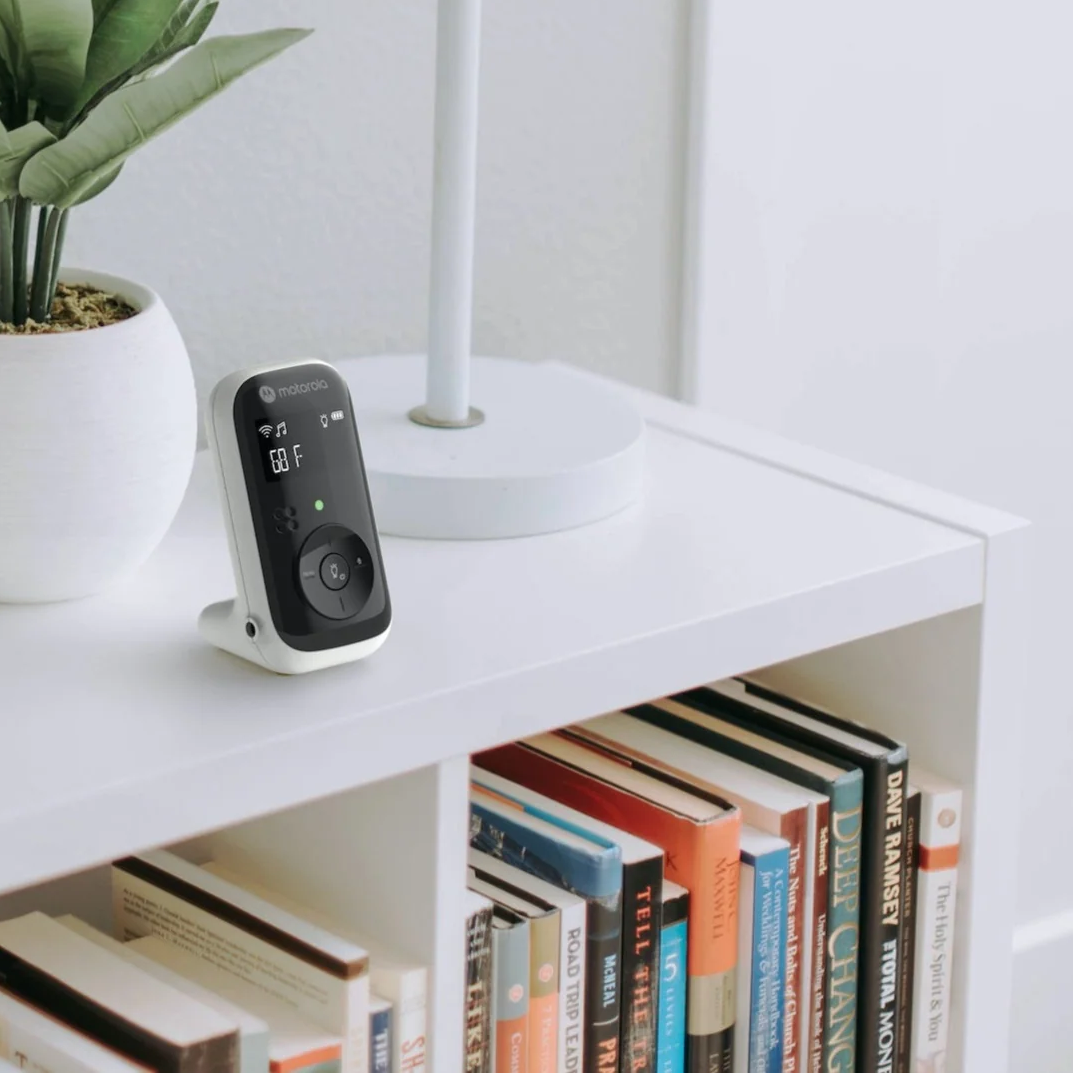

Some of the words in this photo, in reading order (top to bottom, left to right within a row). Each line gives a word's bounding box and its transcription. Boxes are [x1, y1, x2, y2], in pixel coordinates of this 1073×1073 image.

[278, 379, 328, 397] motorola
[270, 448, 289, 473] 68
[293, 444, 302, 467] F
[885, 770, 903, 830] DAVE
[789, 842, 801, 874] The
[817, 827, 828, 876] Schenck
[831, 806, 863, 913] DEEP
[905, 817, 914, 865] CHURCH
[759, 870, 774, 888] for
[774, 867, 784, 877] A
[787, 876, 800, 912] Nuts
[882, 831, 902, 925] RAMSEY
[903, 867, 913, 917] PLANTER
[634, 885, 651, 955] TELL
[712, 857, 727, 943] MAXWELL
[935, 882, 952, 914] The
[757, 890, 773, 957] Weddings
[768, 879, 784, 977] Contemporary
[787, 914, 798, 942] and
[931, 915, 949, 951] Holy
[566, 927, 582, 978] ROAD
[785, 943, 798, 983] Bolts
[814, 914, 826, 991] Understanding
[929, 953, 947, 996] Spirit
[565, 980, 581, 1020] TRIP
[603, 954, 617, 1008] McNEAL
[632, 965, 650, 1024] THE
[784, 985, 797, 998] of
[827, 922, 859, 1073] CHANG
[880, 948, 896, 1008] TOTAL
[467, 979, 483, 1071] LIKE
[769, 979, 781, 1049] Handbook
[784, 999, 797, 1055] Church
[928, 1012, 943, 1042] You
[930, 999, 940, 1012] &
